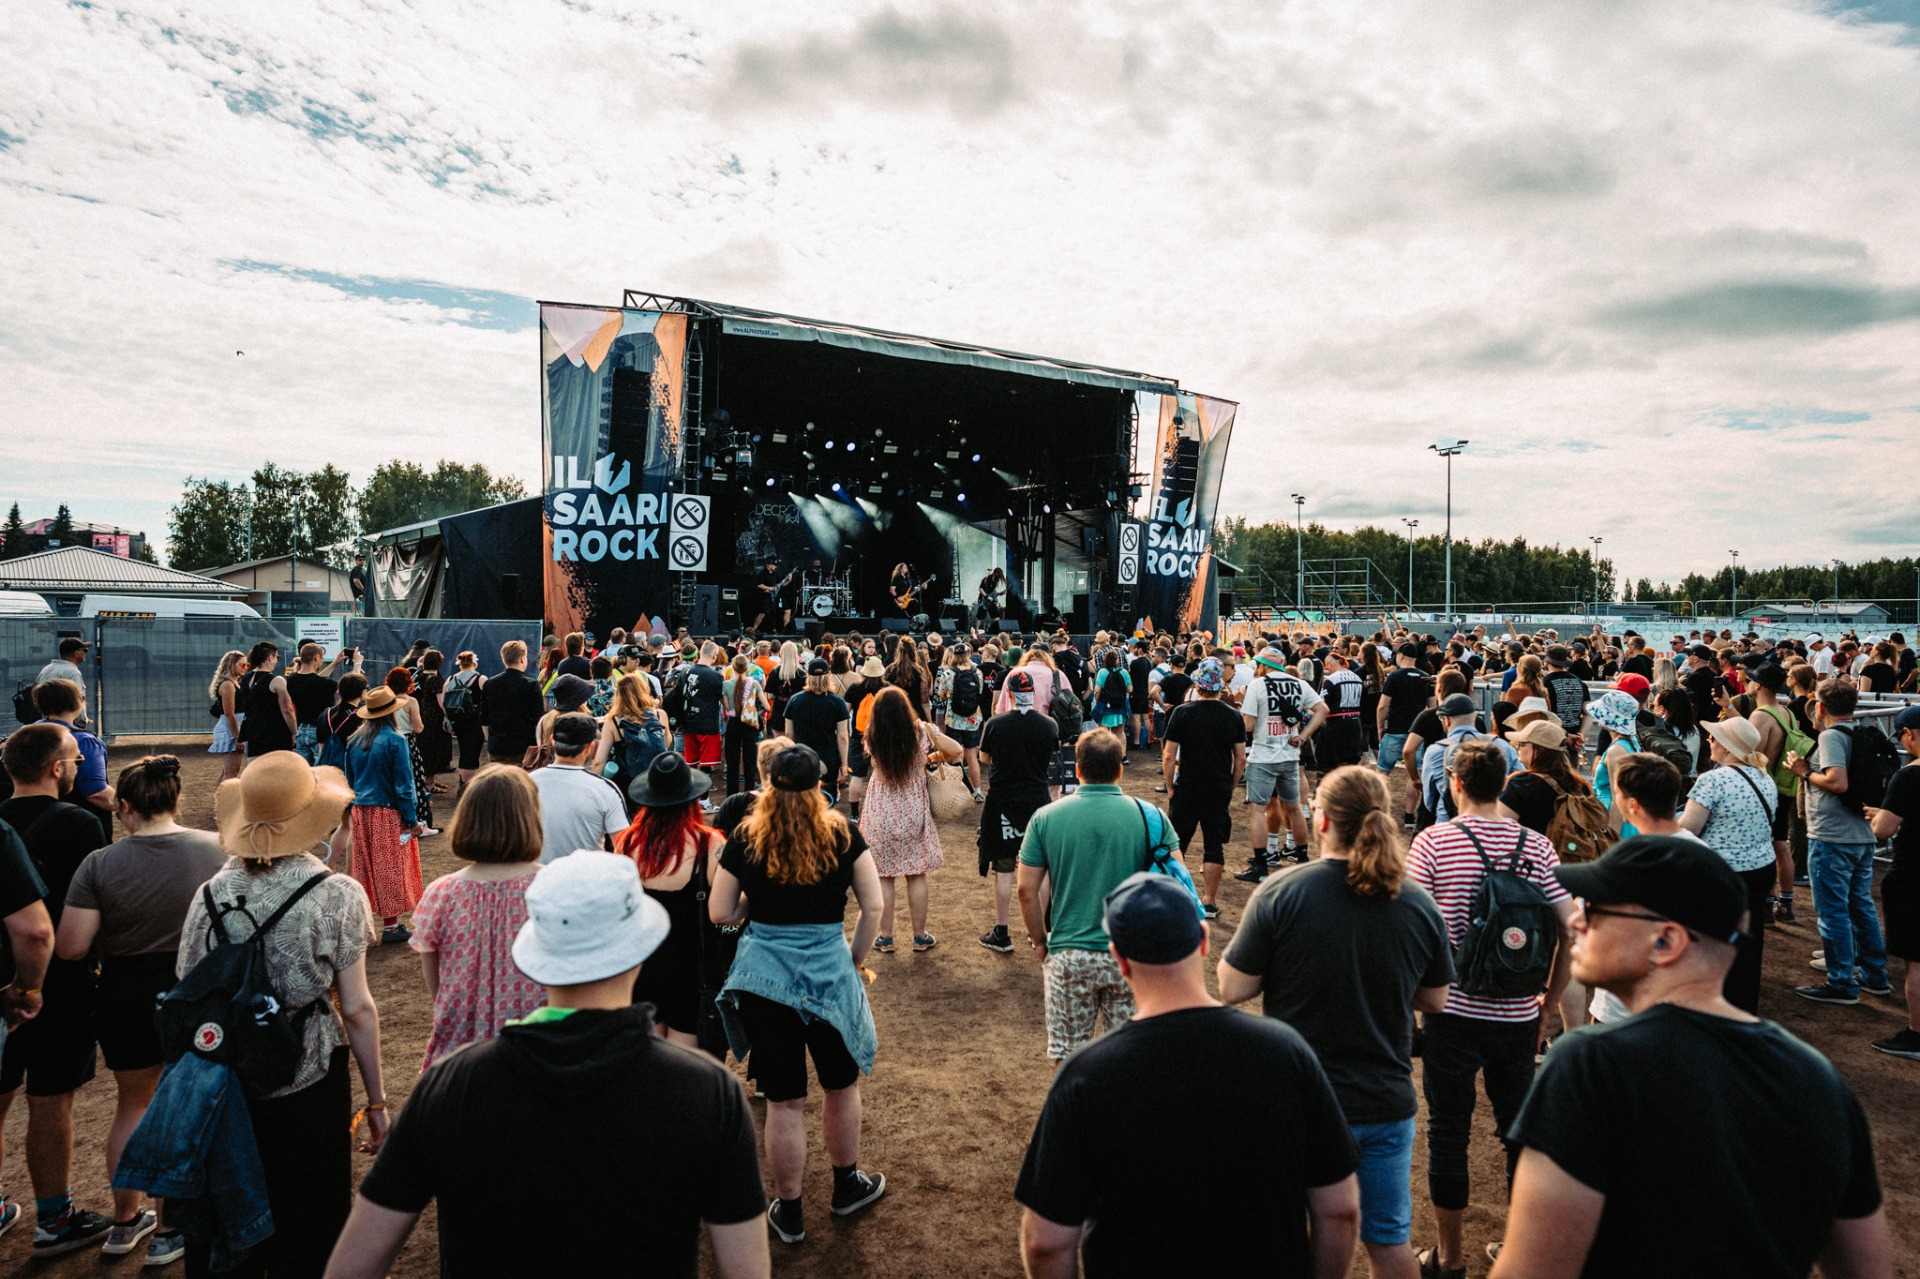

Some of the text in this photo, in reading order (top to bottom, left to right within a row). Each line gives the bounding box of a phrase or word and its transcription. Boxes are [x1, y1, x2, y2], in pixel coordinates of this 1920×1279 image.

[553, 492, 668, 526] SAARI
[552, 528, 660, 562] ROCK
[1148, 522, 1206, 552] SAARI
[1146, 549, 1199, 578] ROCK
[1265, 681, 1302, 696] RUN
